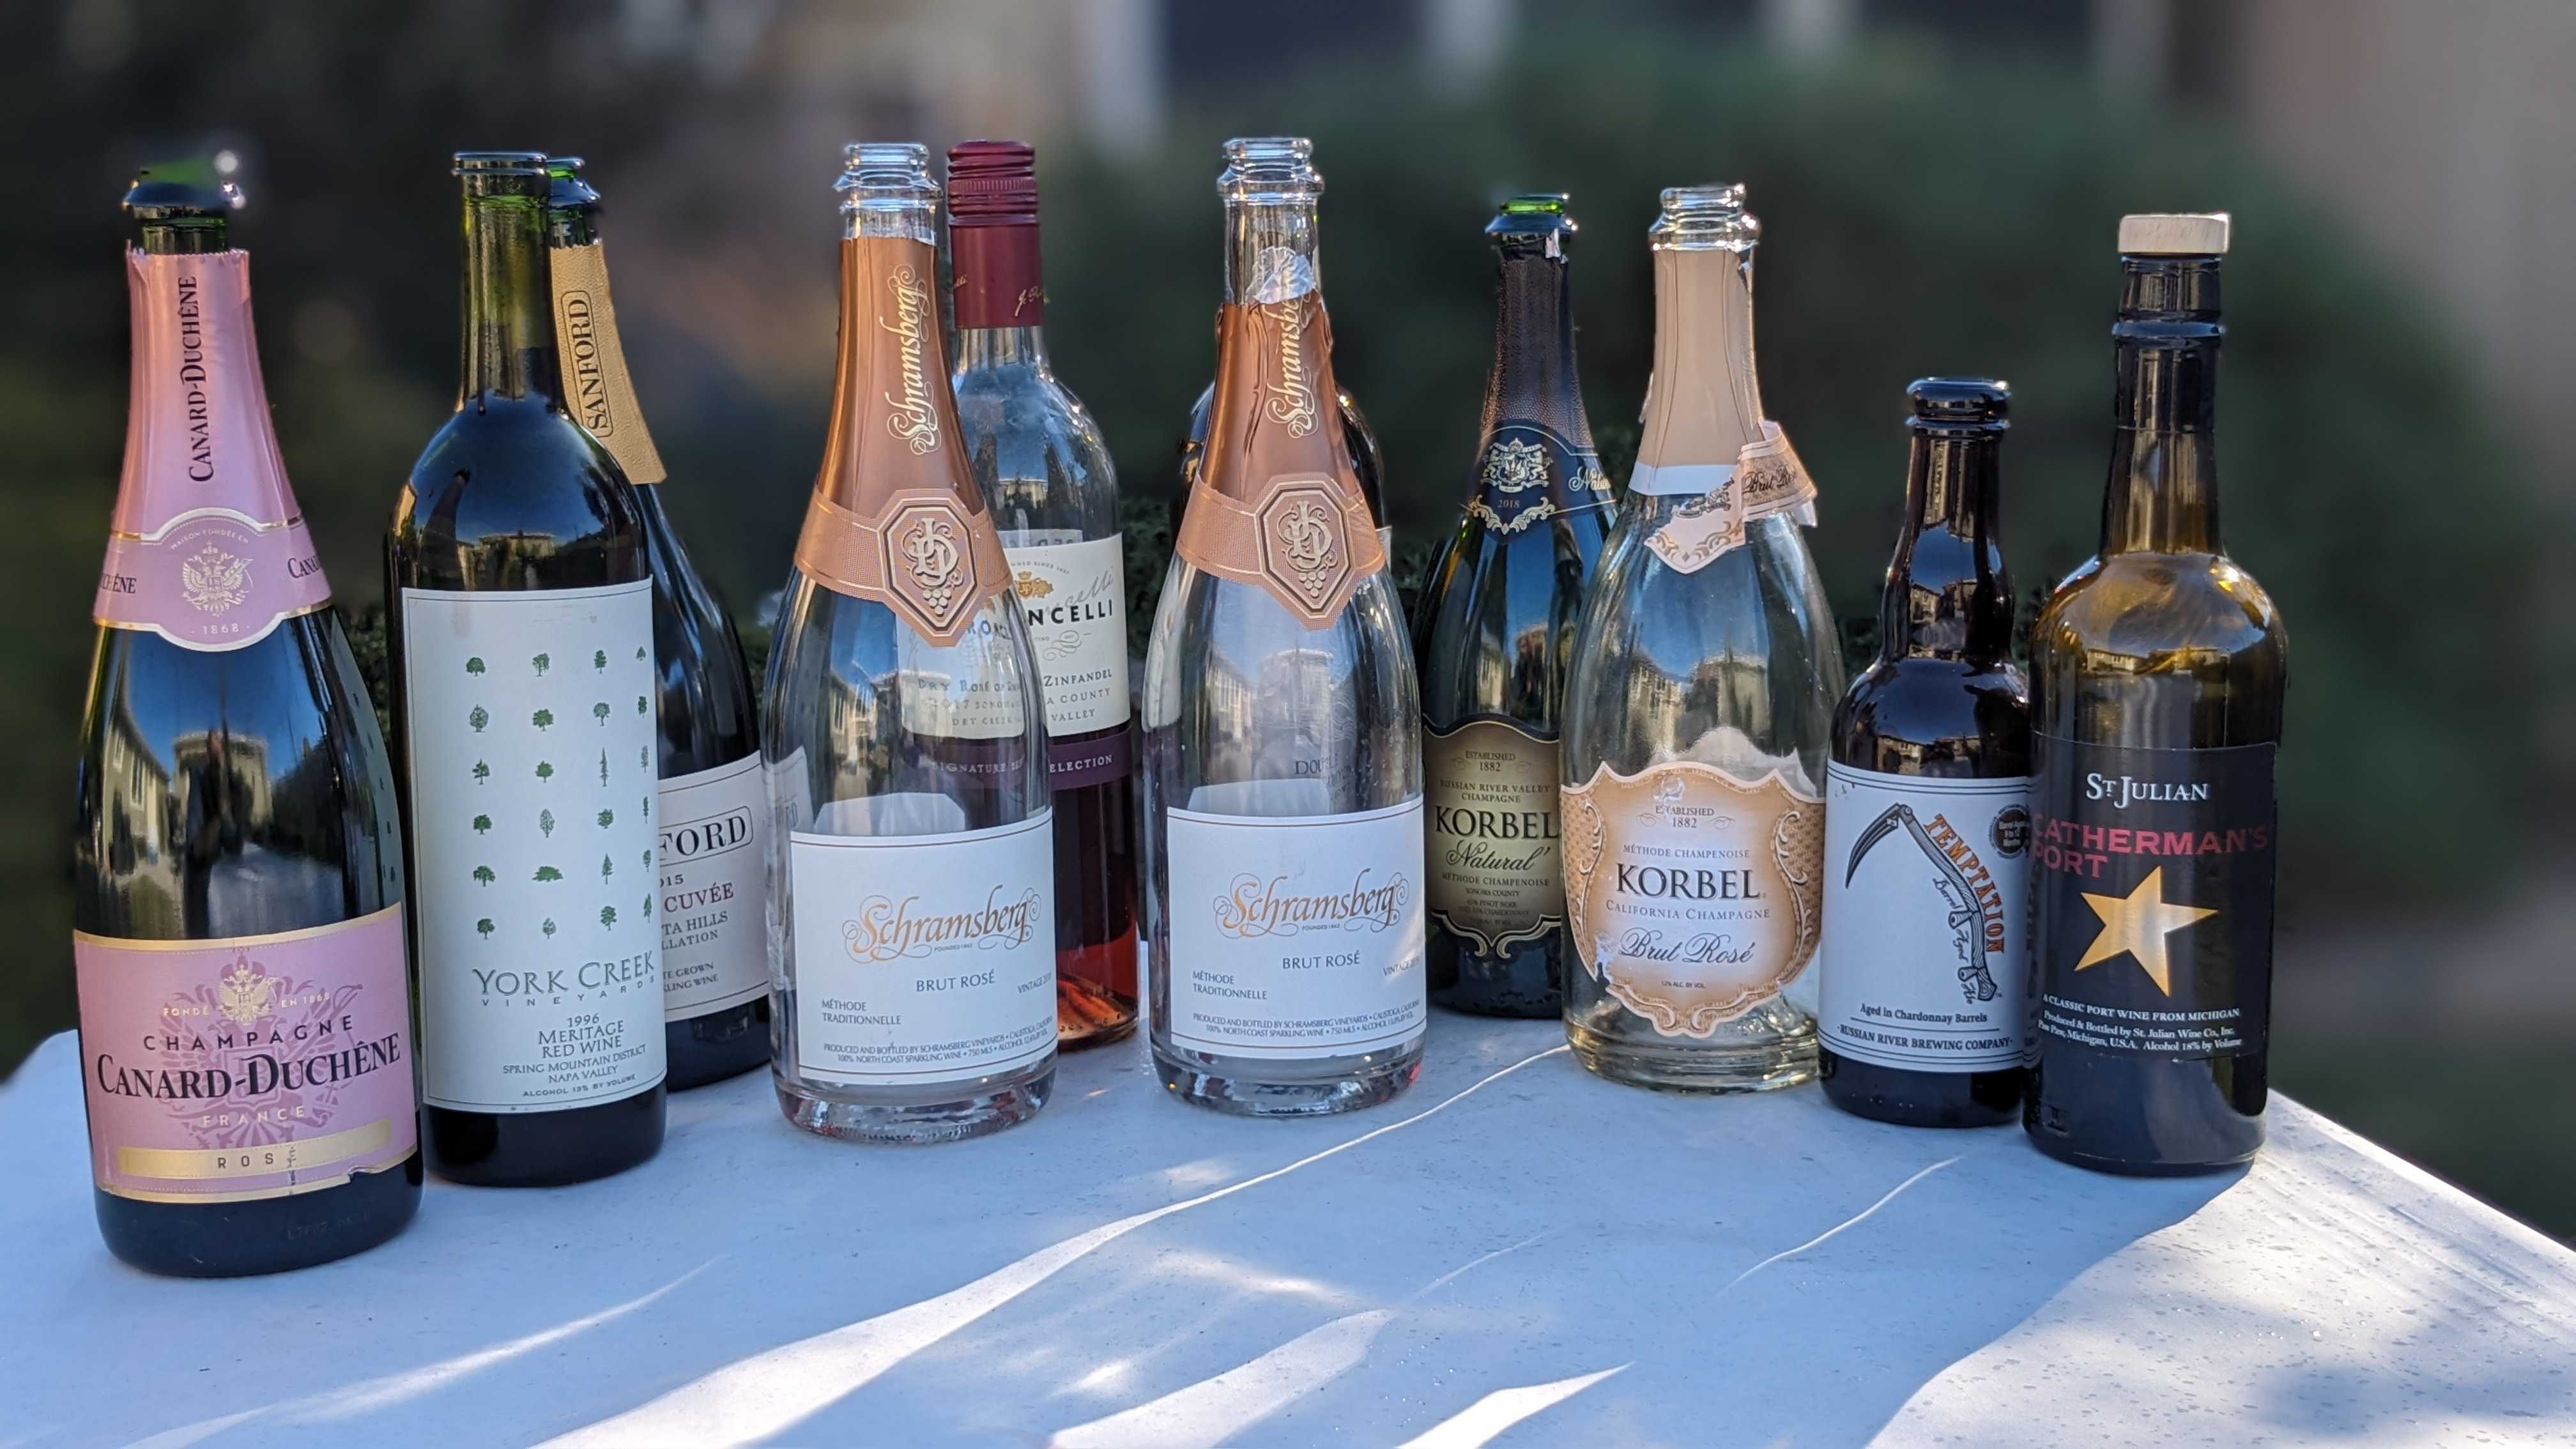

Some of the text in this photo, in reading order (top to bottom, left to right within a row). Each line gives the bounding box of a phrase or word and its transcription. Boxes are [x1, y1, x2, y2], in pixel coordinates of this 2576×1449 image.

[568, 299, 608, 429] SANFORD
[879, 263, 942, 456] Schramsberg
[1498, 500, 1520, 509] 2018
[203, 623, 239, 634] 1868
[1044, 669, 1112, 687] ZINFANDEL
[1061, 687, 1111, 703] COUNTY
[1051, 709, 1095, 721] VALLEY
[1050, 755, 1112, 773] ELECTION
[1480, 762, 1501, 772] 1882
[1440, 779, 1476, 790] RUSSIAN
[1479, 783, 1508, 793] RIVER
[1462, 793, 1521, 803] CHAMPAGNE
[1435, 806, 1560, 839] KORBEL
[1672, 817, 1697, 829] 1882
[659, 815, 746, 861] FORD
[1623, 843, 1750, 859] MÉTHODE CHAMPENOISE
[1483, 877, 1549, 887] CHAMPENOISE
[1616, 862, 1761, 900] KORBEL
[1923, 813, 2005, 953] TEMPTATION
[664, 882, 735, 913] CUVÉE
[1213, 868, 1409, 939] Schramsberg
[1606, 899, 1770, 921] CALIFORNIA CHAMPAGNE
[662, 910, 728, 937] TA HILLS
[843, 884, 1041, 963] Schramsberg
[1931, 878, 1964, 910] Barrel
[1952, 929, 1970, 963] Aged
[1618, 927, 1756, 964] Brut Rosé
[1283, 950, 1360, 969] BRUT ROSÉ
[473, 951, 654, 996] YORK CREEK
[676, 962, 714, 977] GROWN
[1193, 970, 1234, 985] MÉTHODE
[694, 973, 719, 986] WINE
[917, 969, 995, 992] BRUT ROSÉ
[1017, 976, 1044, 993] VINTAGE
[482, 976, 655, 1007] VINEYARDS
[1193, 983, 1268, 1000] TRADITIONNELLE
[281, 999, 298, 1008] EN
[822, 999, 867, 1011] MÉTHODE
[2043, 993, 2239, 1021] A CLASSIC PORT WINE FROM MICHIGAN
[567, 1013, 599, 1027] 1996
[823, 1013, 901, 1025] TRADITIONNELLE
[1860, 1002, 1988, 1025] Aged in Chardonnay Barrels
[144, 1015, 353, 1051] CHAMPAGNE
[538, 1020, 624, 1045] MERITAGE
[1227, 1018, 1241, 1027] AND
[1243, 1019, 1273, 1029] BOTTLED
[2044, 1009, 2076, 1027] Produced
[2076, 1020, 2085, 1029] &
[2086, 1021, 2118, 1035] Bottled
[2119, 1026, 2132, 1039] by
[2147, 1029, 2175, 1039] Julian
[2177, 1029, 2202, 1038] Wine
[542, 1036, 622, 1059] RED WINE
[824, 1043, 859, 1054] PRODUCED
[861, 1046, 875, 1054] AND
[1877, 1034, 1908, 1048] RIVER
[1911, 1038, 1963, 1050] BREWING
[2143, 1041, 2179, 1051] Alcohol
[2202, 1039, 2213, 1052] by
[97, 1032, 401, 1100] CANARD-DUCHÊNE
[503, 1044, 647, 1074] SPRING MOUNTAIN DISTRICT
[856, 1055, 880, 1063] NORTH
[881, 1055, 904, 1063] COAST
[548, 1065, 618, 1084] NAPA VALLEY
[523, 1087, 568, 1097] ALCOHOL
[593, 1082, 604, 1090] BY
[607, 1074, 636, 1087] VOLUME
[203, 1105, 305, 1126] FRANCE
